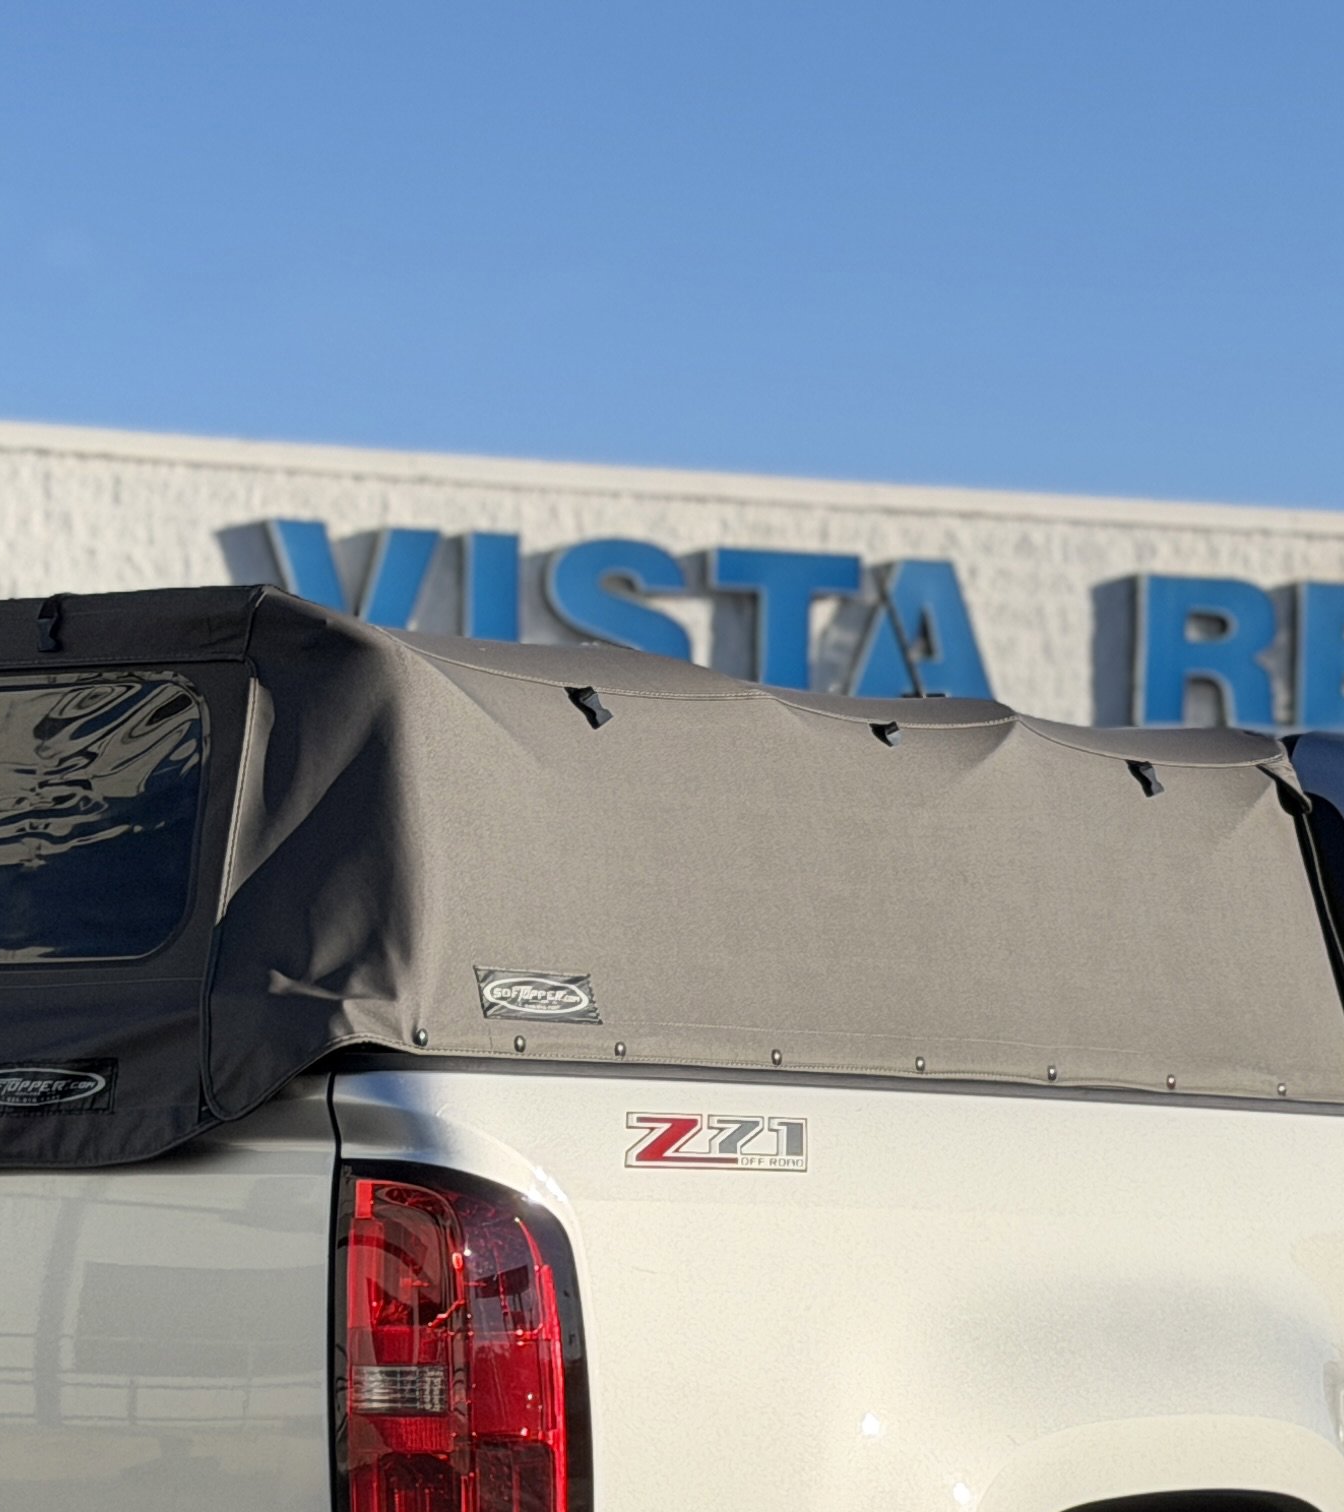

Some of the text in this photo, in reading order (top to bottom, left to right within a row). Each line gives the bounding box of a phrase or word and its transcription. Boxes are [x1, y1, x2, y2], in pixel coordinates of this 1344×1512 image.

[266, 519, 996, 700] VISTA
[624, 1112, 808, 1168] Z71
[740, 1156, 805, 1167] OFF ROAD
